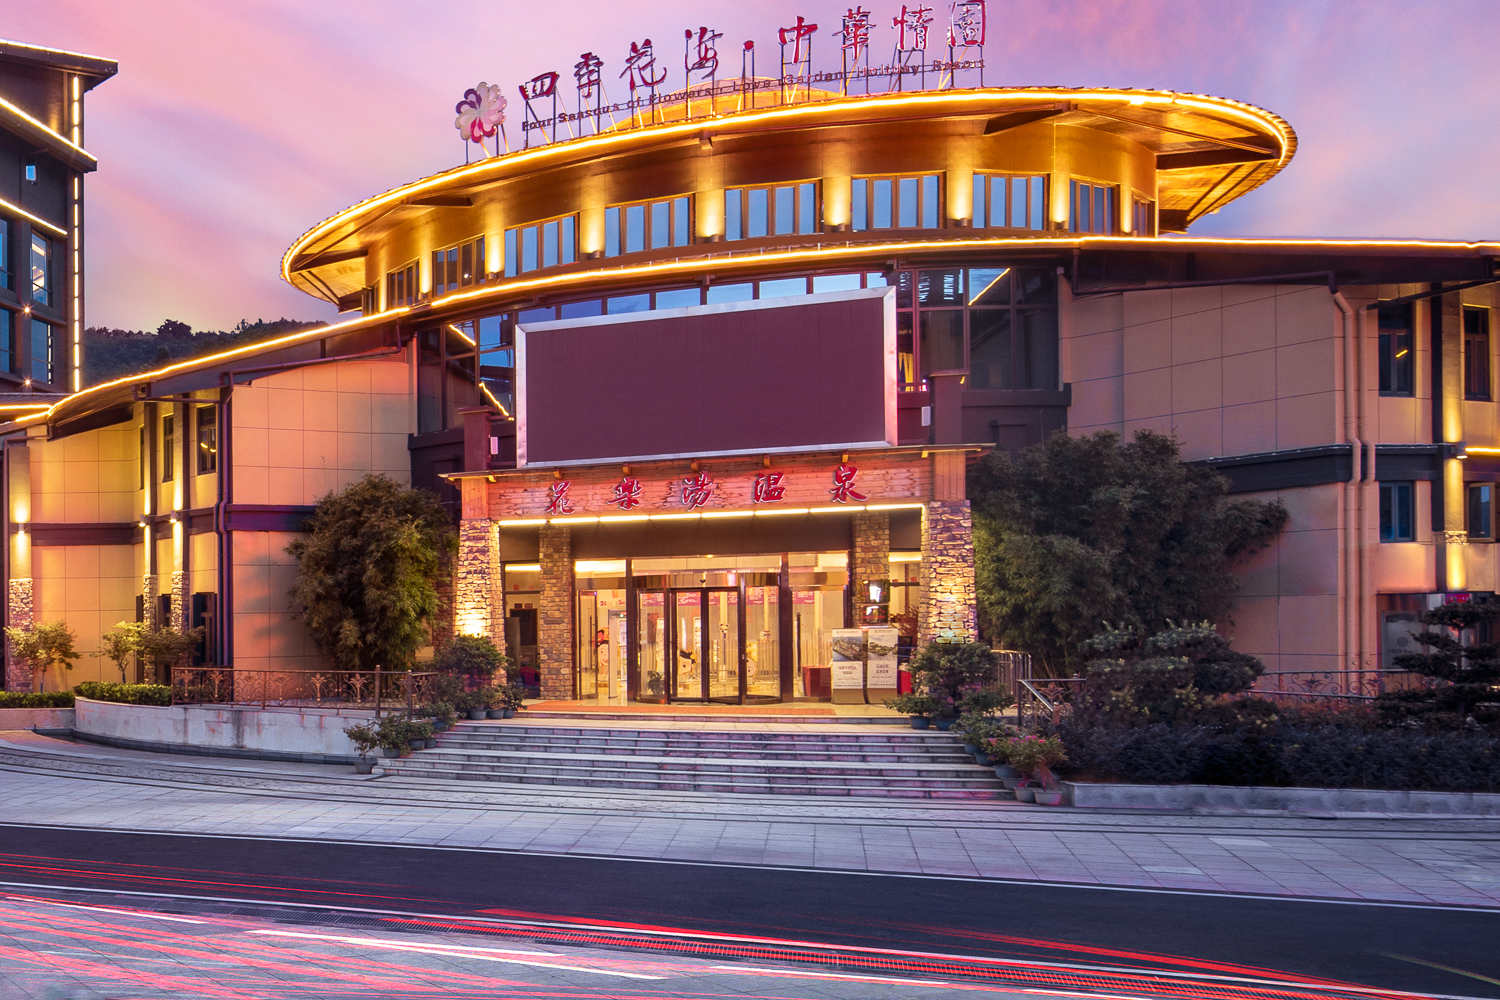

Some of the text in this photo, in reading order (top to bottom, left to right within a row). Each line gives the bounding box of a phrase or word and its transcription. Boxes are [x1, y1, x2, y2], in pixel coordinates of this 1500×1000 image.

[522, 117, 553, 131] Four
[783, 71, 843, 85] Garden
[857, 63, 920, 78] Holiday
[932, 58, 985, 72] Resort
